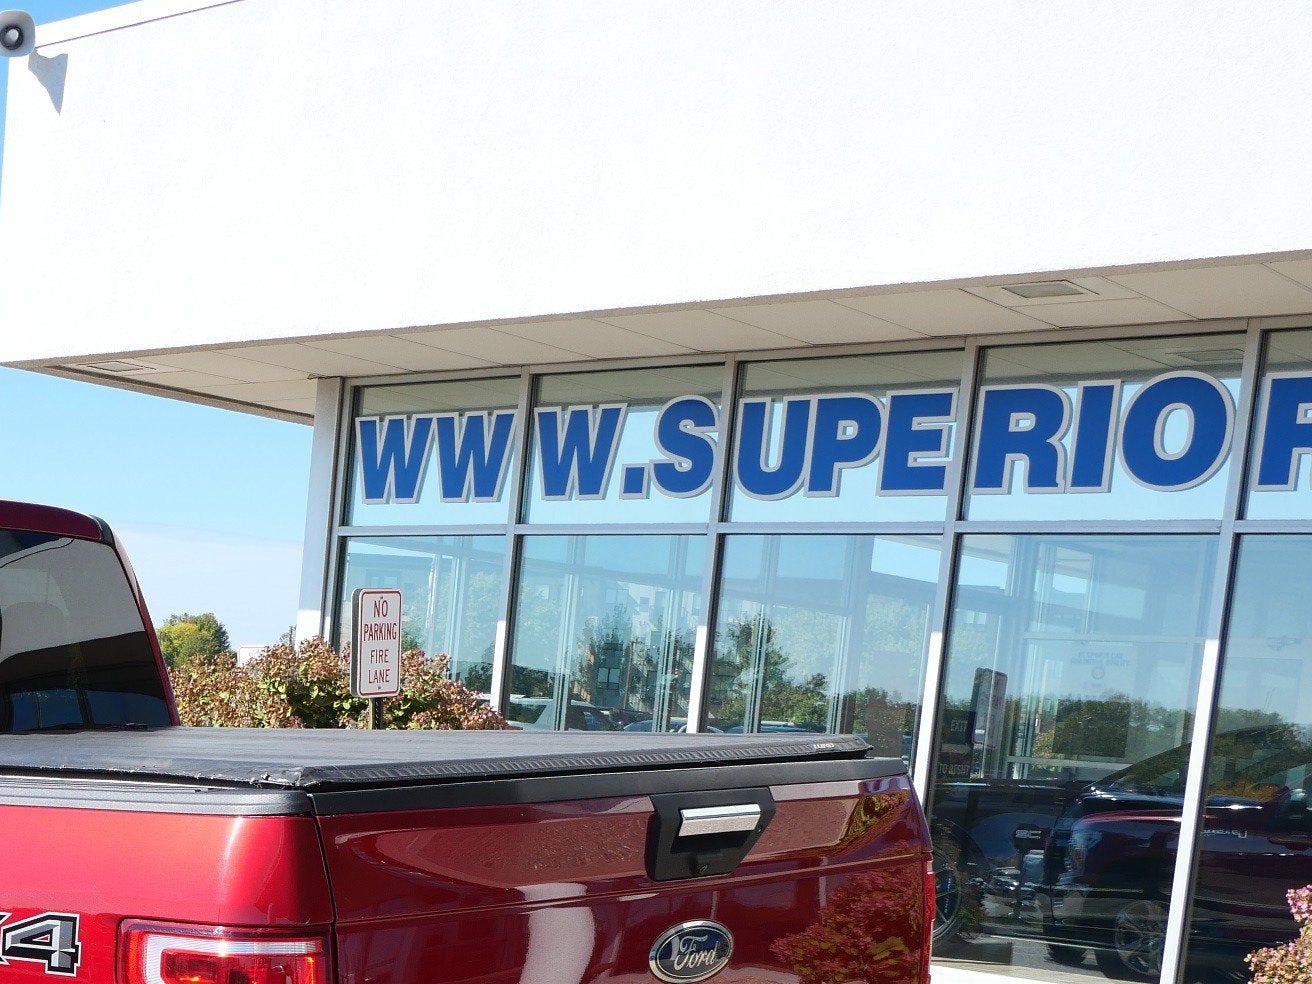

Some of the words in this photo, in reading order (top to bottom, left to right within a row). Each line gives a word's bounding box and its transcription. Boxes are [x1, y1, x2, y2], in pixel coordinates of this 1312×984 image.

[373, 599, 388, 618] NO
[363, 622, 397, 641] PARKING
[370, 649, 389, 664] FIRE
[368, 669, 390, 684] LANE
[674, 934, 720, 971] Ford
